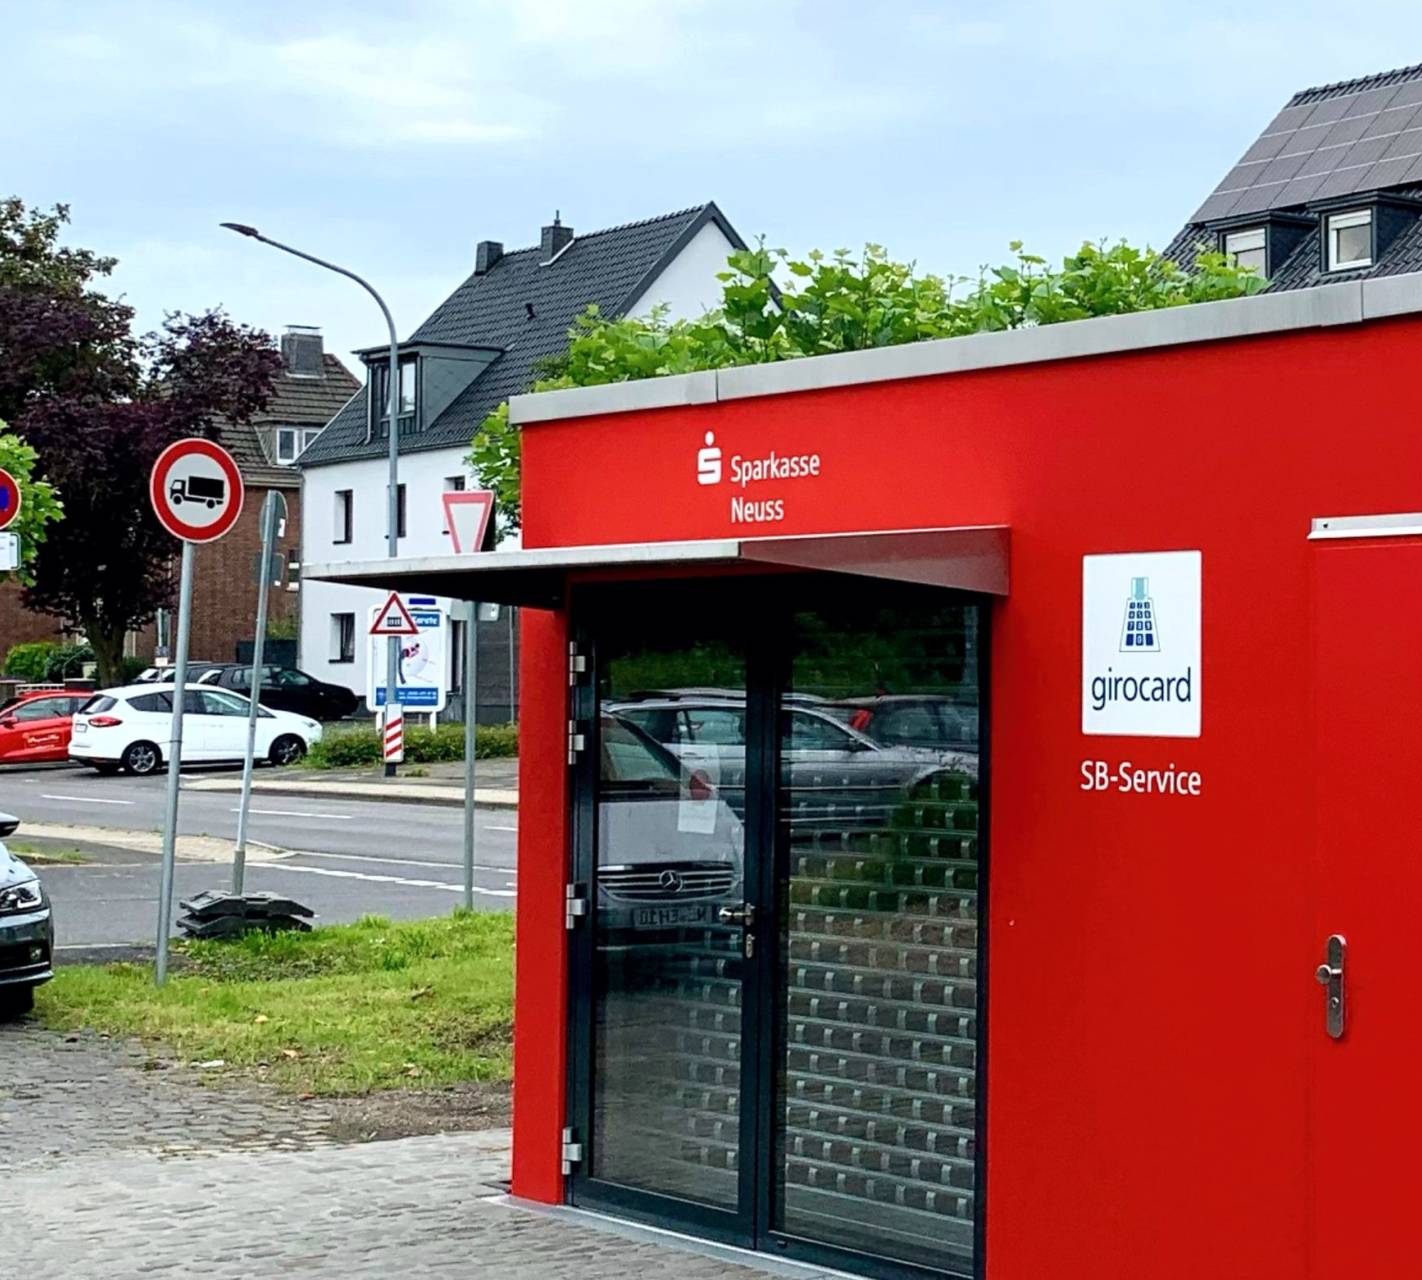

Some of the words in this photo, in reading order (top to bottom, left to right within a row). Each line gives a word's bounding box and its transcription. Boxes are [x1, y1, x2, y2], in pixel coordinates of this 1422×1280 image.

[730, 451, 820, 488] Sparkasse
[731, 496, 784, 523] Neuss
[1091, 666, 1191, 711] girocard
[1081, 760, 1201, 795] SB-Service
